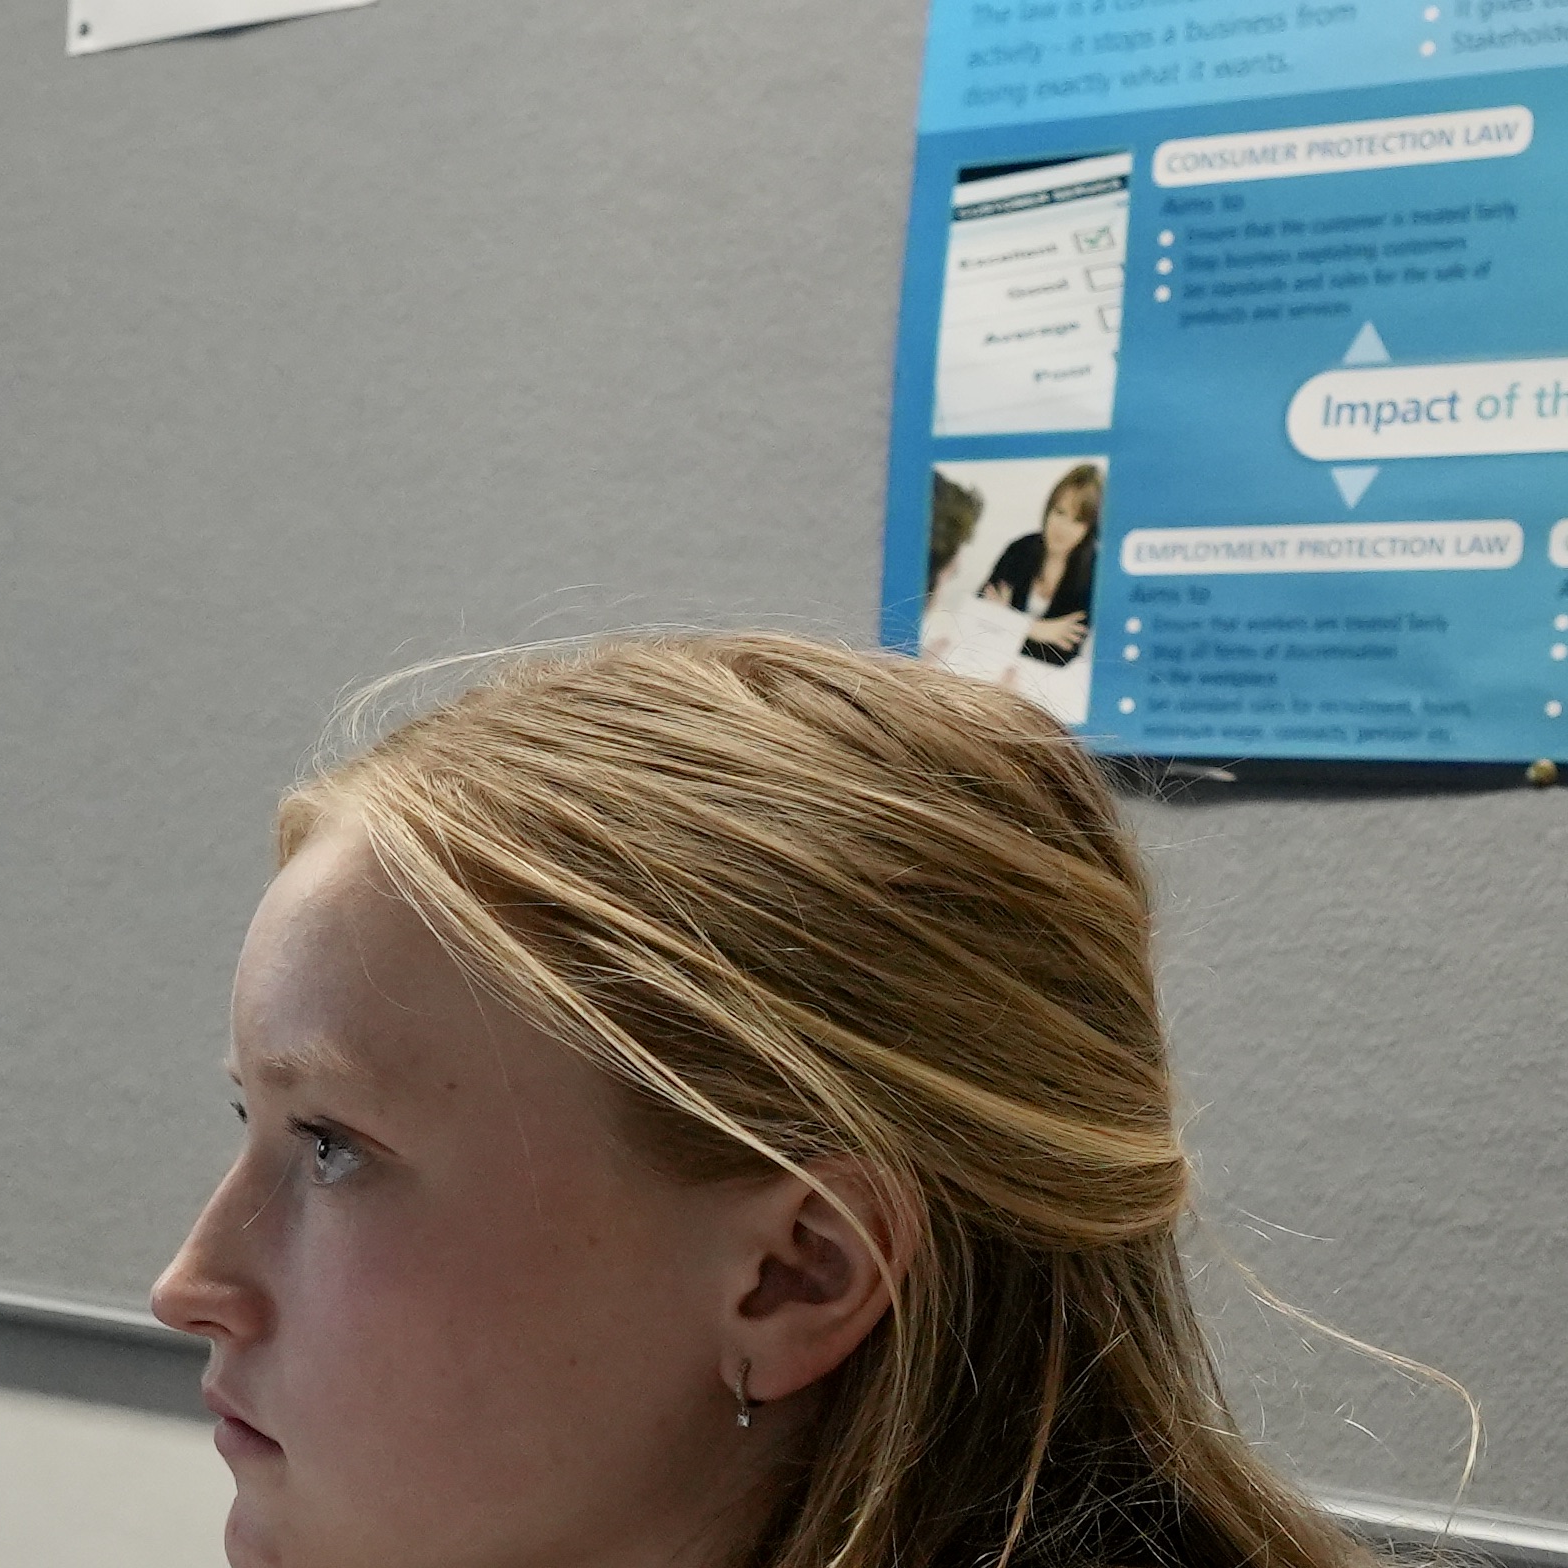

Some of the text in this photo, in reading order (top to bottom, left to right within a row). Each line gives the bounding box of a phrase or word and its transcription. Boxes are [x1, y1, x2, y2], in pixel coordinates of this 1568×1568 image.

[1166, 120, 1522, 175] CONSUMER PROTECTION LAW
[1321, 391, 1462, 434] Impact
[1475, 381, 1522, 422] of
[1134, 534, 1511, 563] EMPLOYMENT PROTECTION LAW
